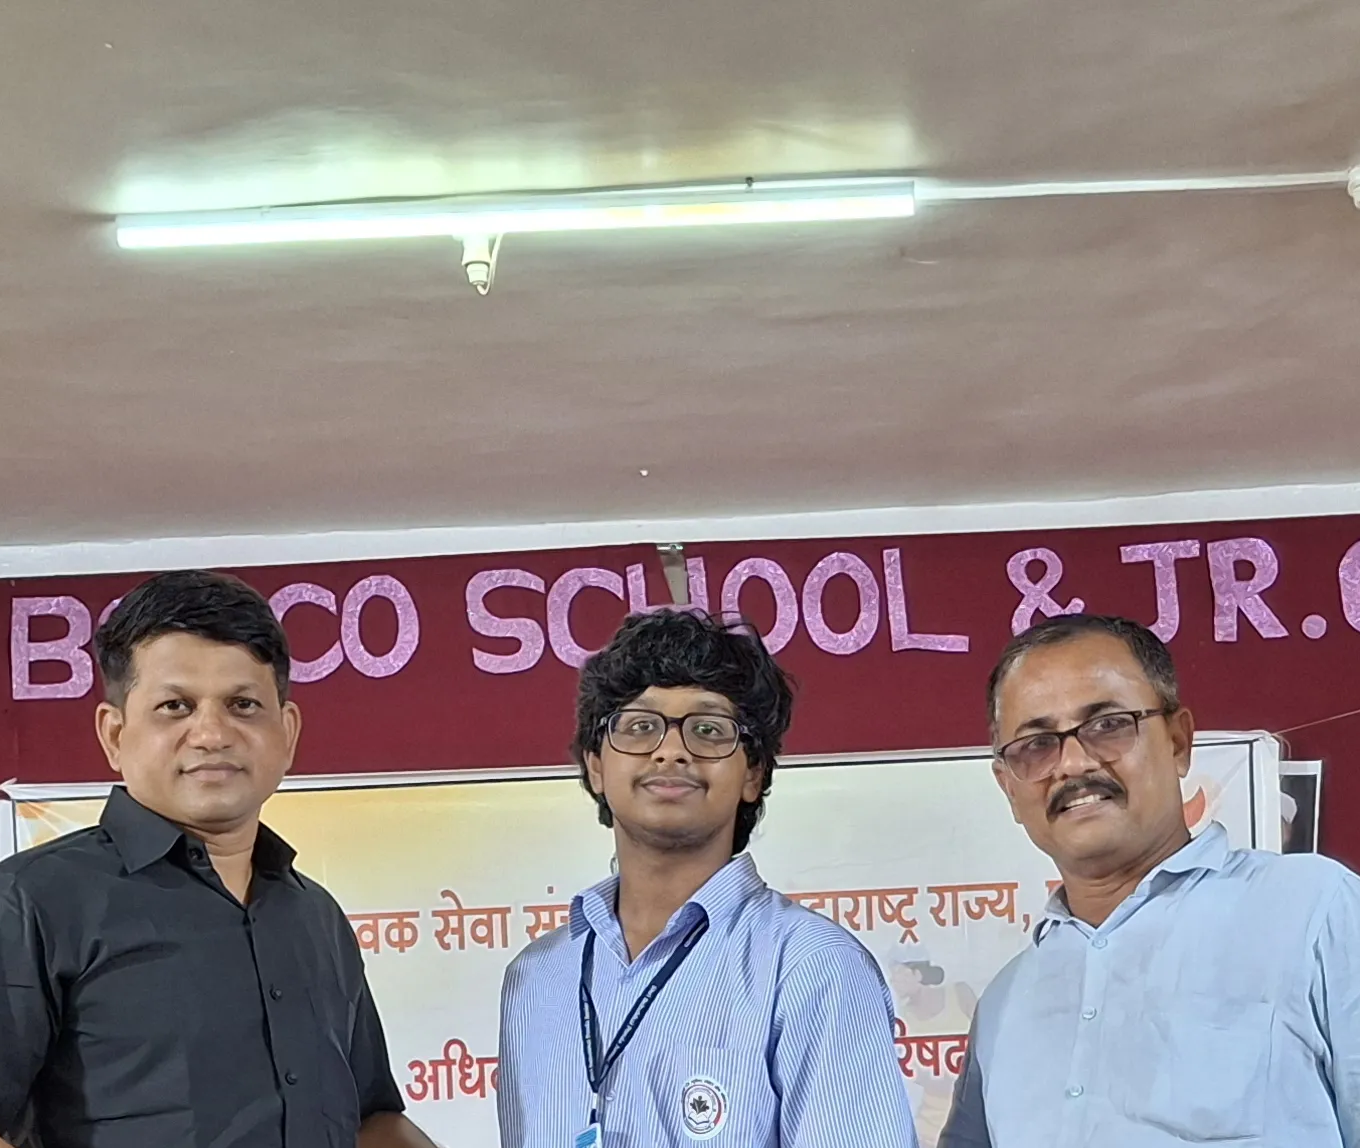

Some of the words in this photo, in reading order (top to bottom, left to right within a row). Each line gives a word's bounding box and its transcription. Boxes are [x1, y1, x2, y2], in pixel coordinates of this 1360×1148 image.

[10, 574, 421, 701] BCO
[1006, 547, 1086, 637] &
[345, 910, 420, 955] वक
[431, 889, 512, 951] सेवा
[926, 881, 1031, 934] राज्य,
[404, 1038, 500, 1101] अधि
